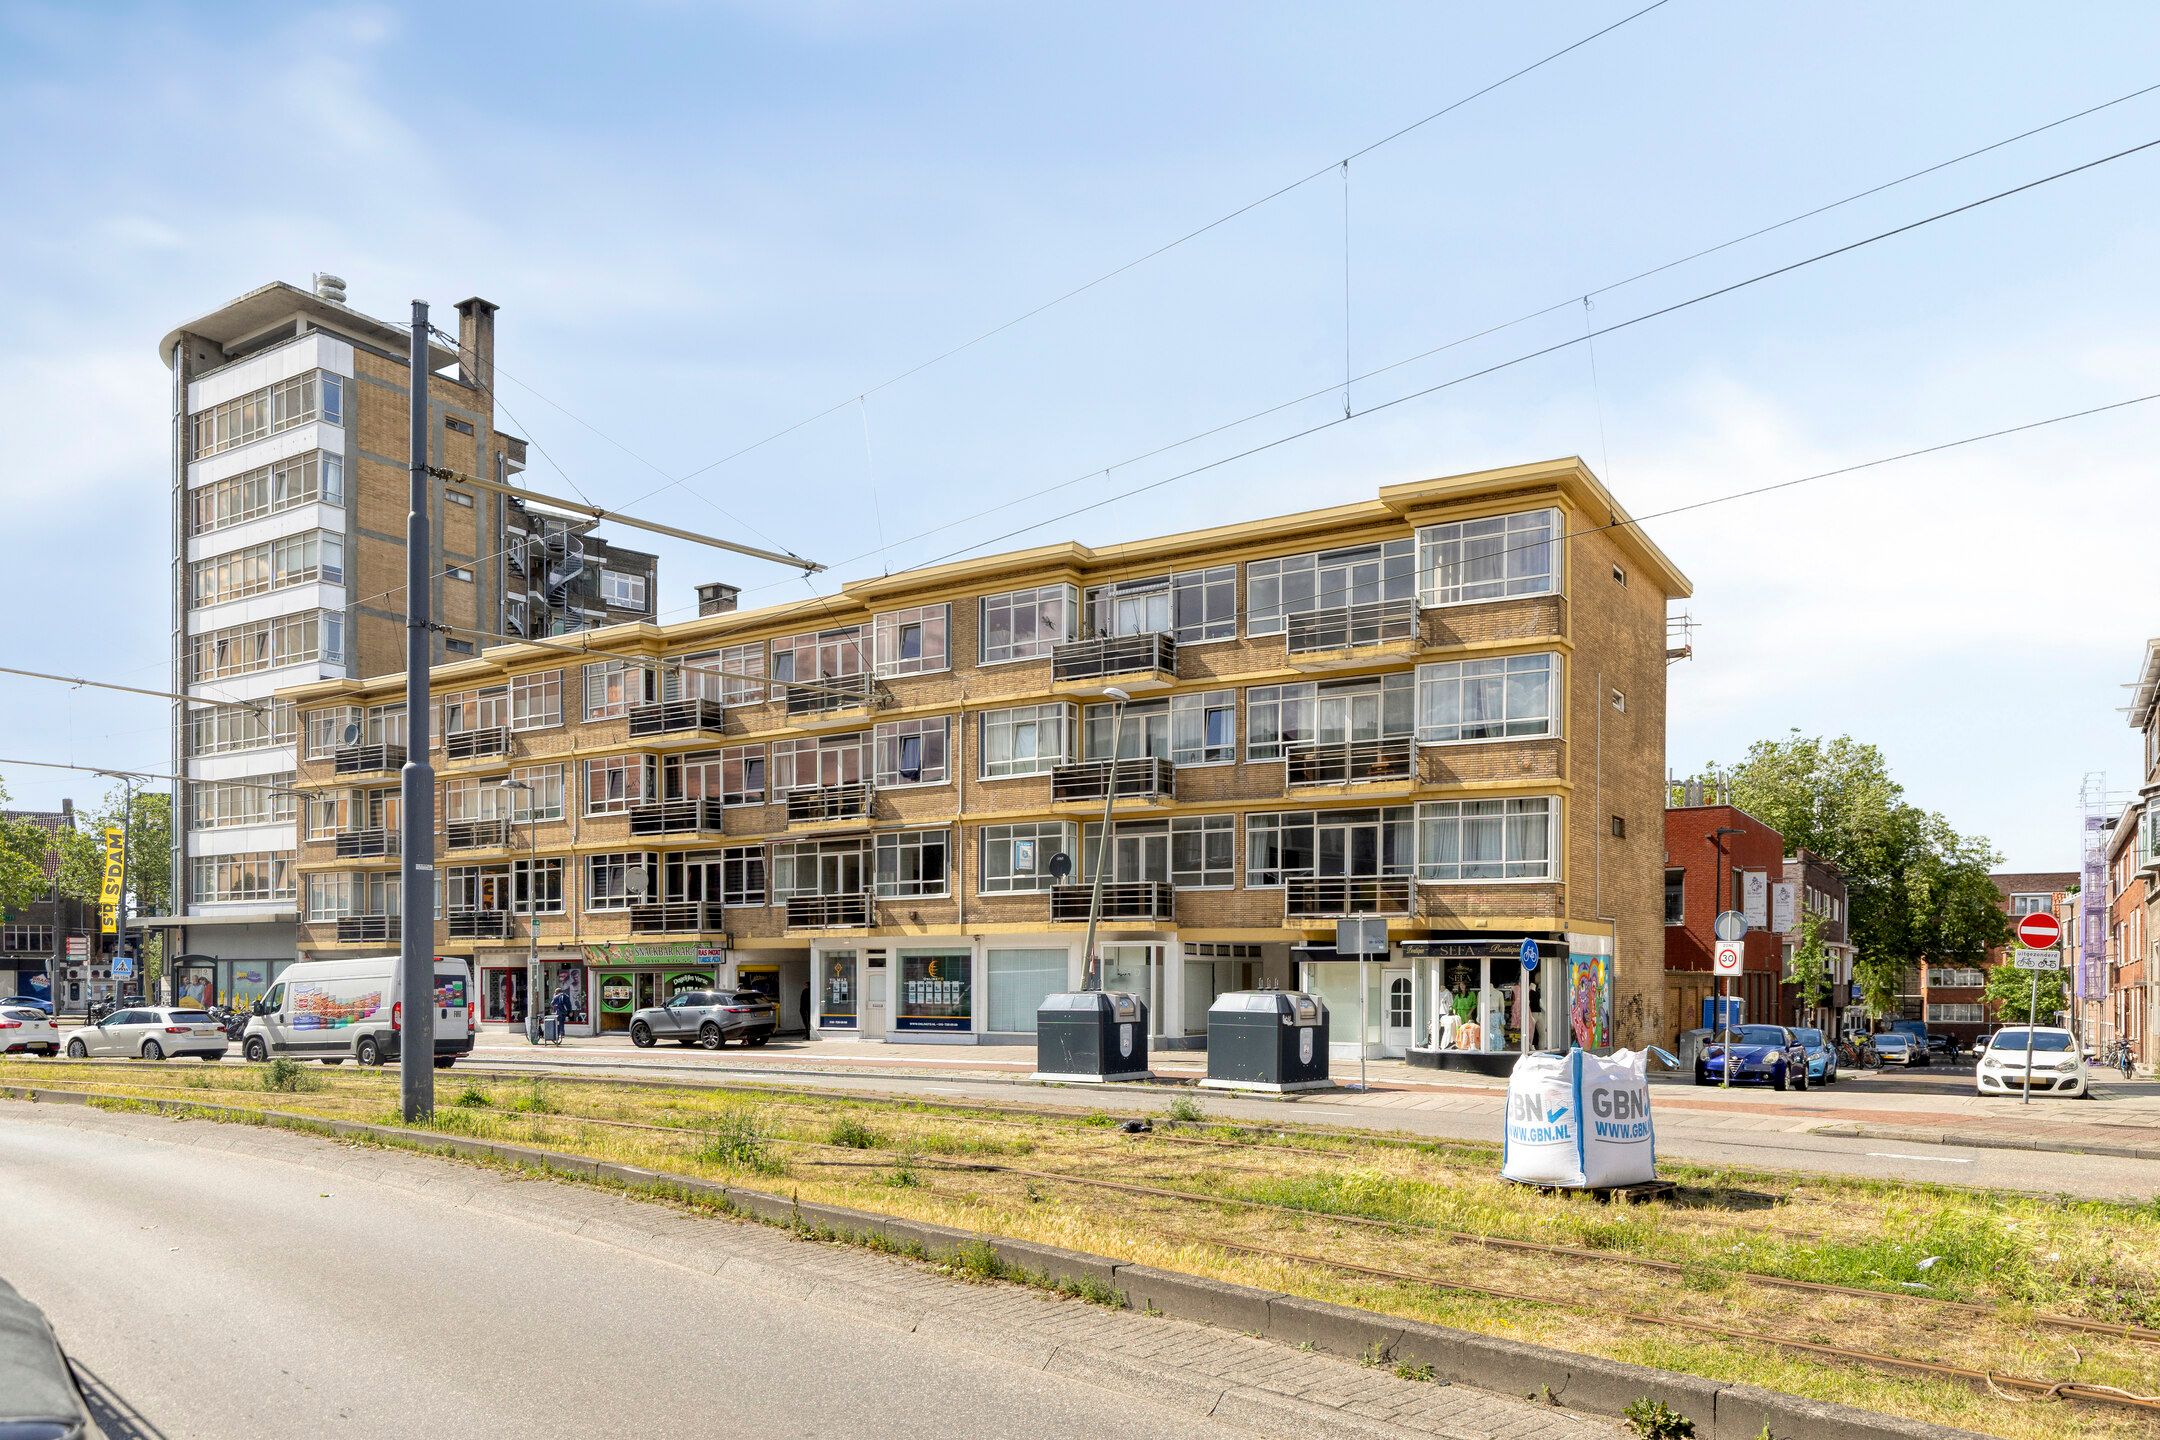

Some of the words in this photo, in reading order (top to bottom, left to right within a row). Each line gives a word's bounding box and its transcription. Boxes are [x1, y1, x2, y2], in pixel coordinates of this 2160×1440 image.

[105, 833, 123, 896] S'DAM
[103, 903, 114, 926] S'D
[635, 947, 673, 957] SNACKBAR
[1440, 946, 1476, 956] SEFA
[1489, 944, 1520, 955] Boutiqu
[1721, 954, 1734, 963] 30
[695, 975, 709, 985] Verse
[1448, 974, 1472, 982] SEFA
[1592, 1087, 1644, 1120] GBN
[1595, 1120, 1650, 1139] WWW.GBN.
